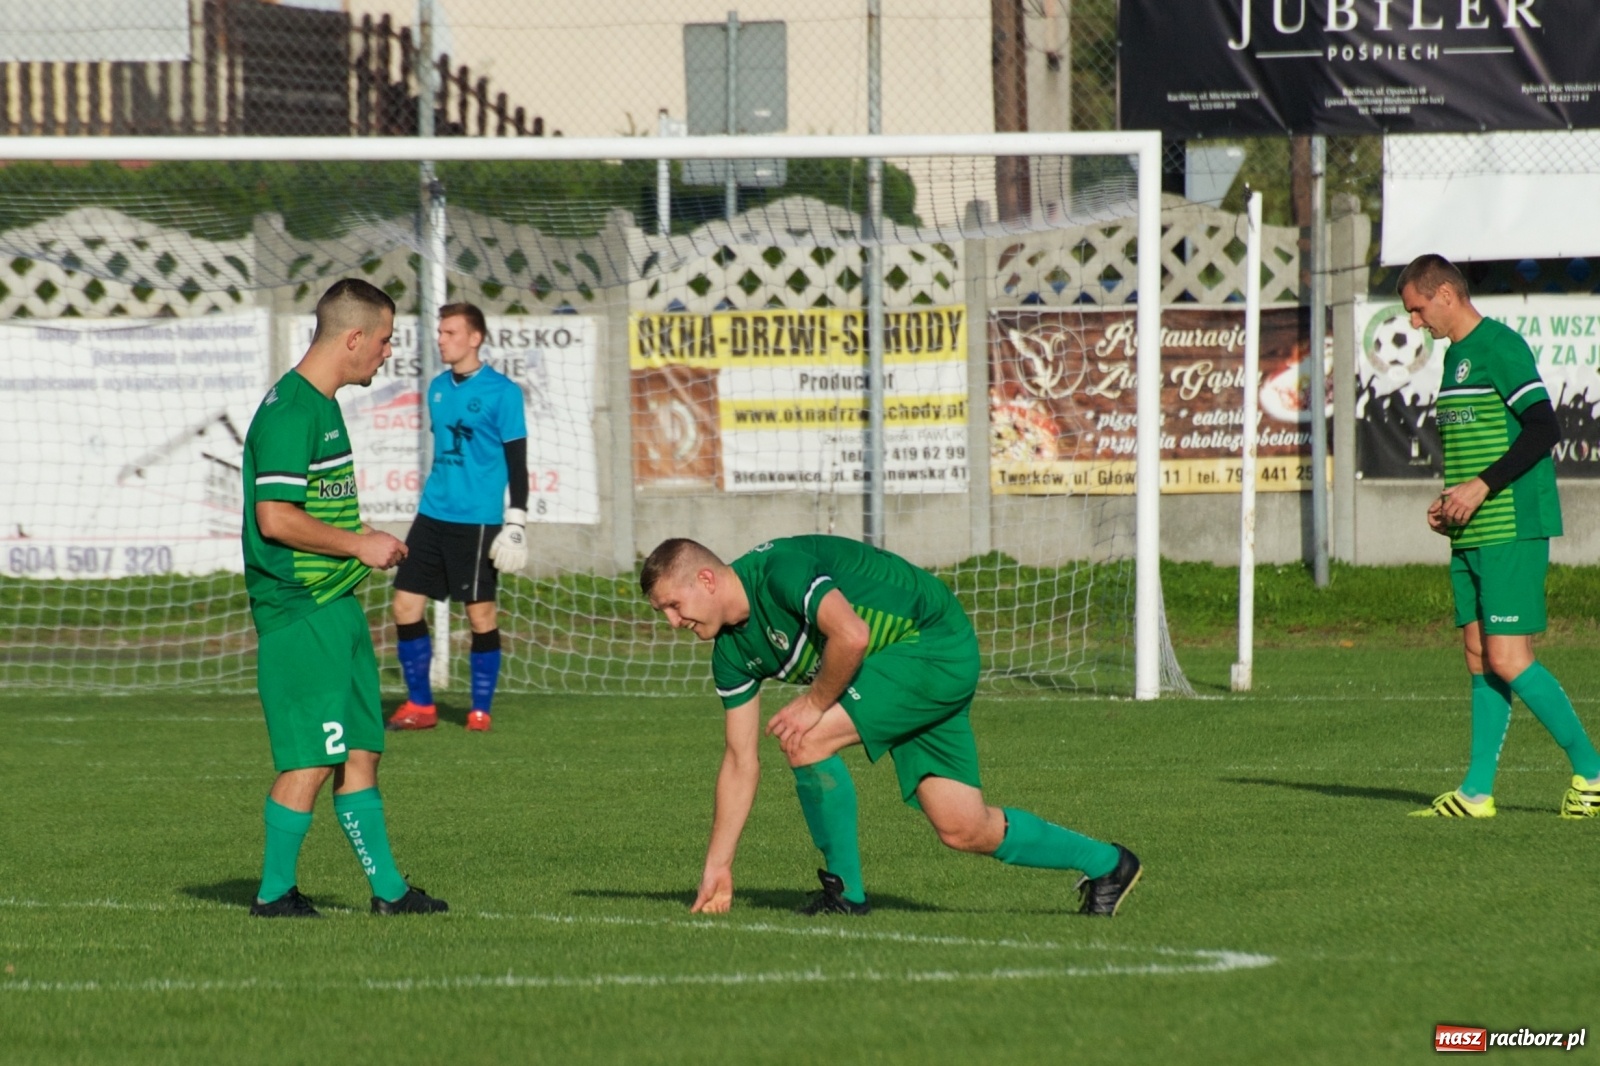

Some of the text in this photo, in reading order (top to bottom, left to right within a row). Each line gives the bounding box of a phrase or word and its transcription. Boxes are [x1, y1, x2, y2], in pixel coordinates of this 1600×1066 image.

[1327, 44, 1439, 61] POŚPIECH
[1550, 316, 1600, 336] WSZ
[1551, 345, 1577, 365] ZA
[946, 446, 965, 459] 99
[951, 467, 966, 479] 41
[1098, 470, 1137, 485] Głów
[1164, 471, 1180, 483] 11
[1198, 471, 1220, 483] tel.
[1261, 467, 1287, 480] 441
[9, 546, 173, 573] 604 507 320
[322, 721, 346, 756] 2
